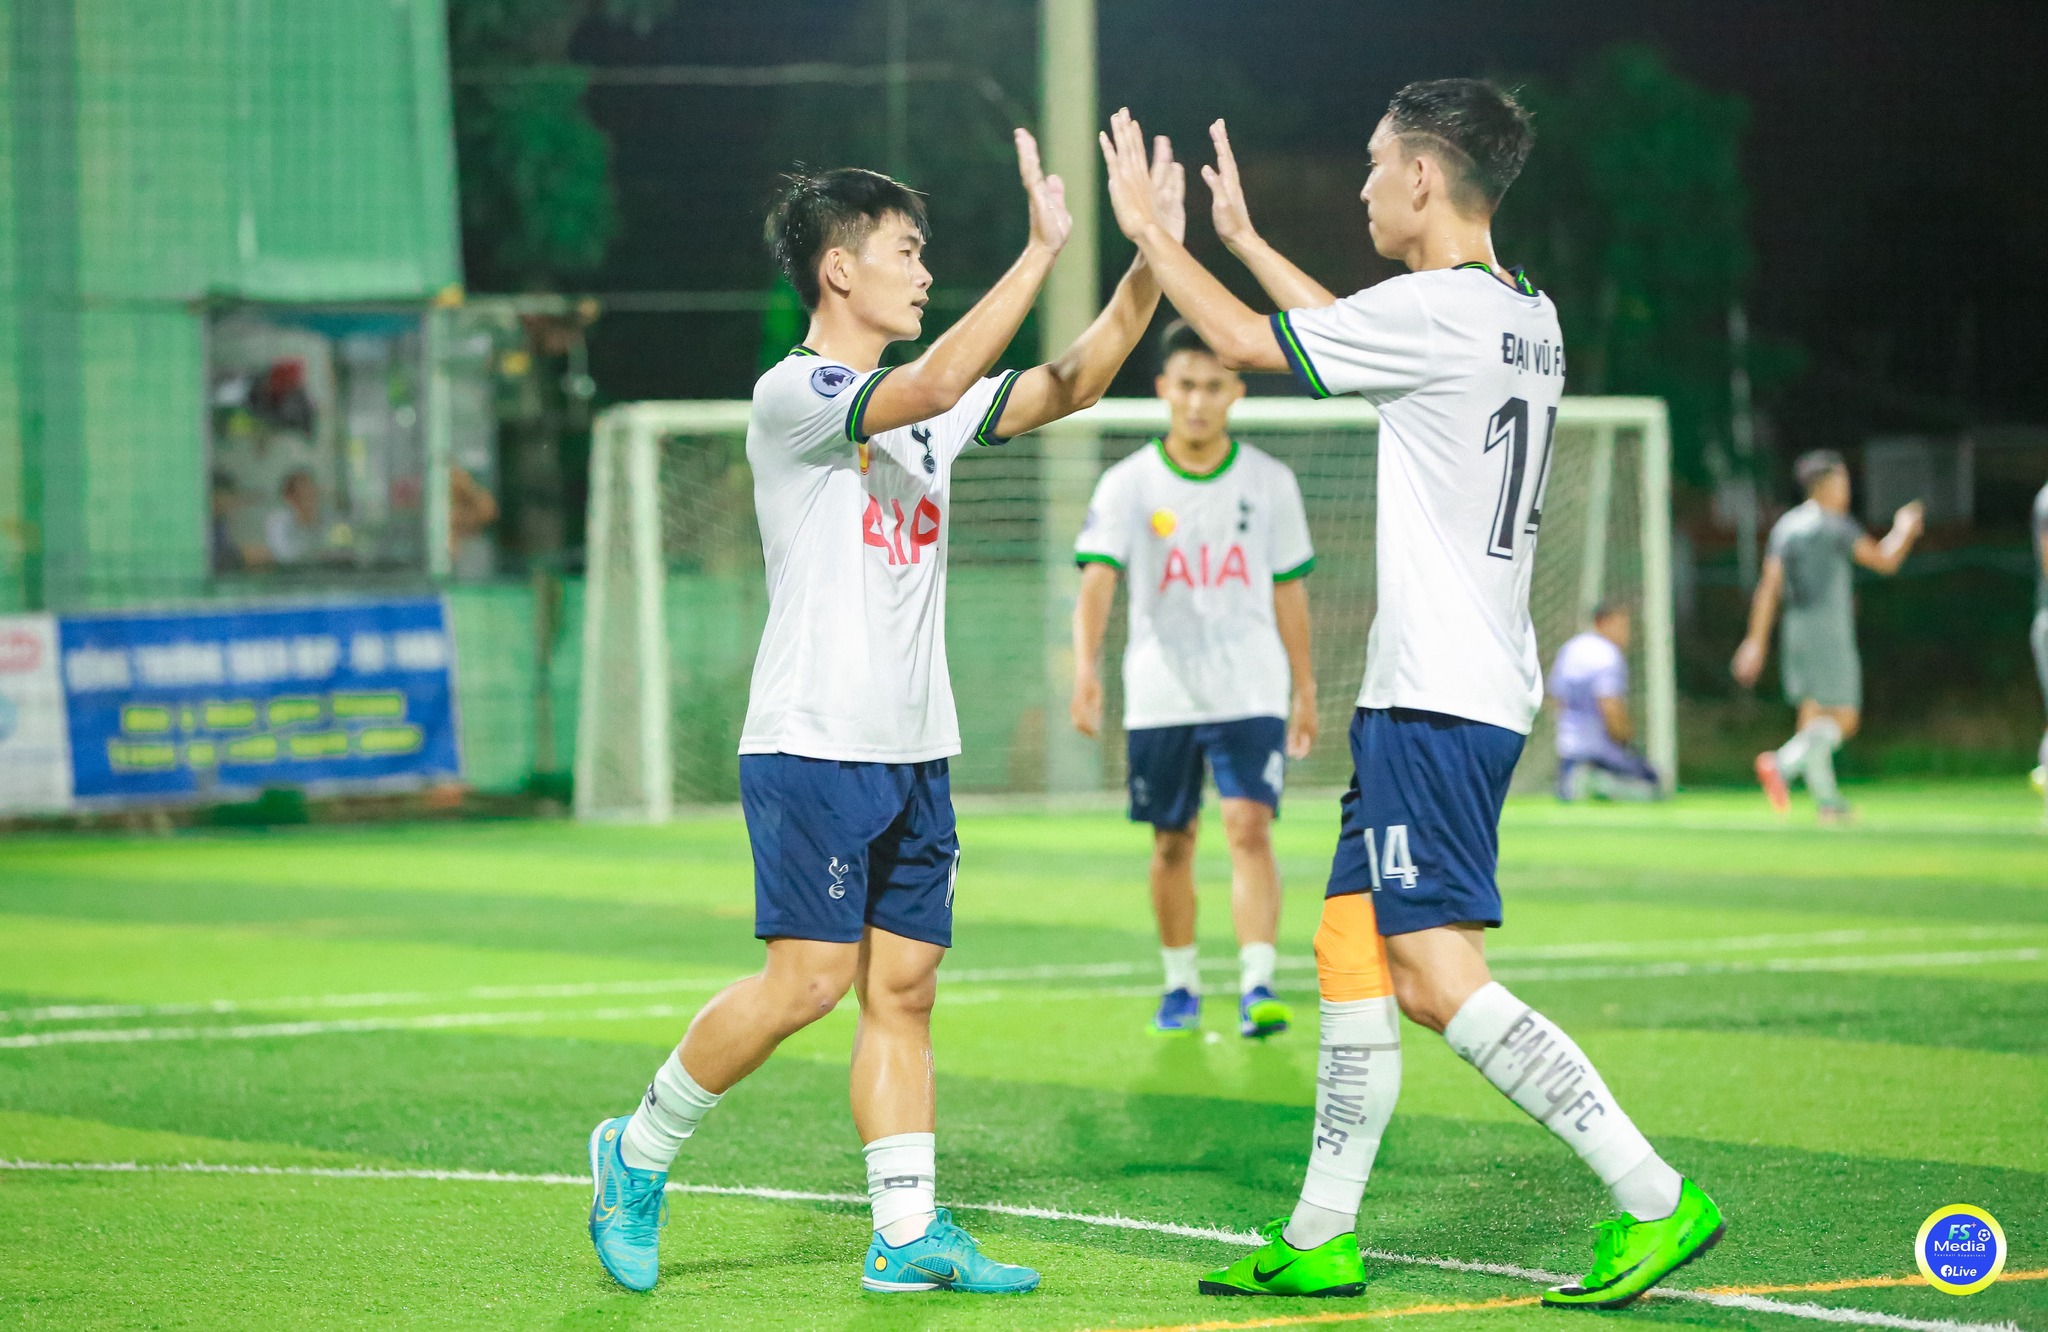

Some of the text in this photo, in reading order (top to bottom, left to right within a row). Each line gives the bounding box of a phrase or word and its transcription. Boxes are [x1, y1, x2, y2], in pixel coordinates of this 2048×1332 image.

[1158, 543, 1252, 595] AIA
[1363, 824, 1419, 892] 14
[1325, 1045, 1371, 1086] ĐẠI
[1499, 1015, 1556, 1070] ĐẠI
[1563, 1089, 1605, 1133] FC
[1317, 1123, 1349, 1156] FC
